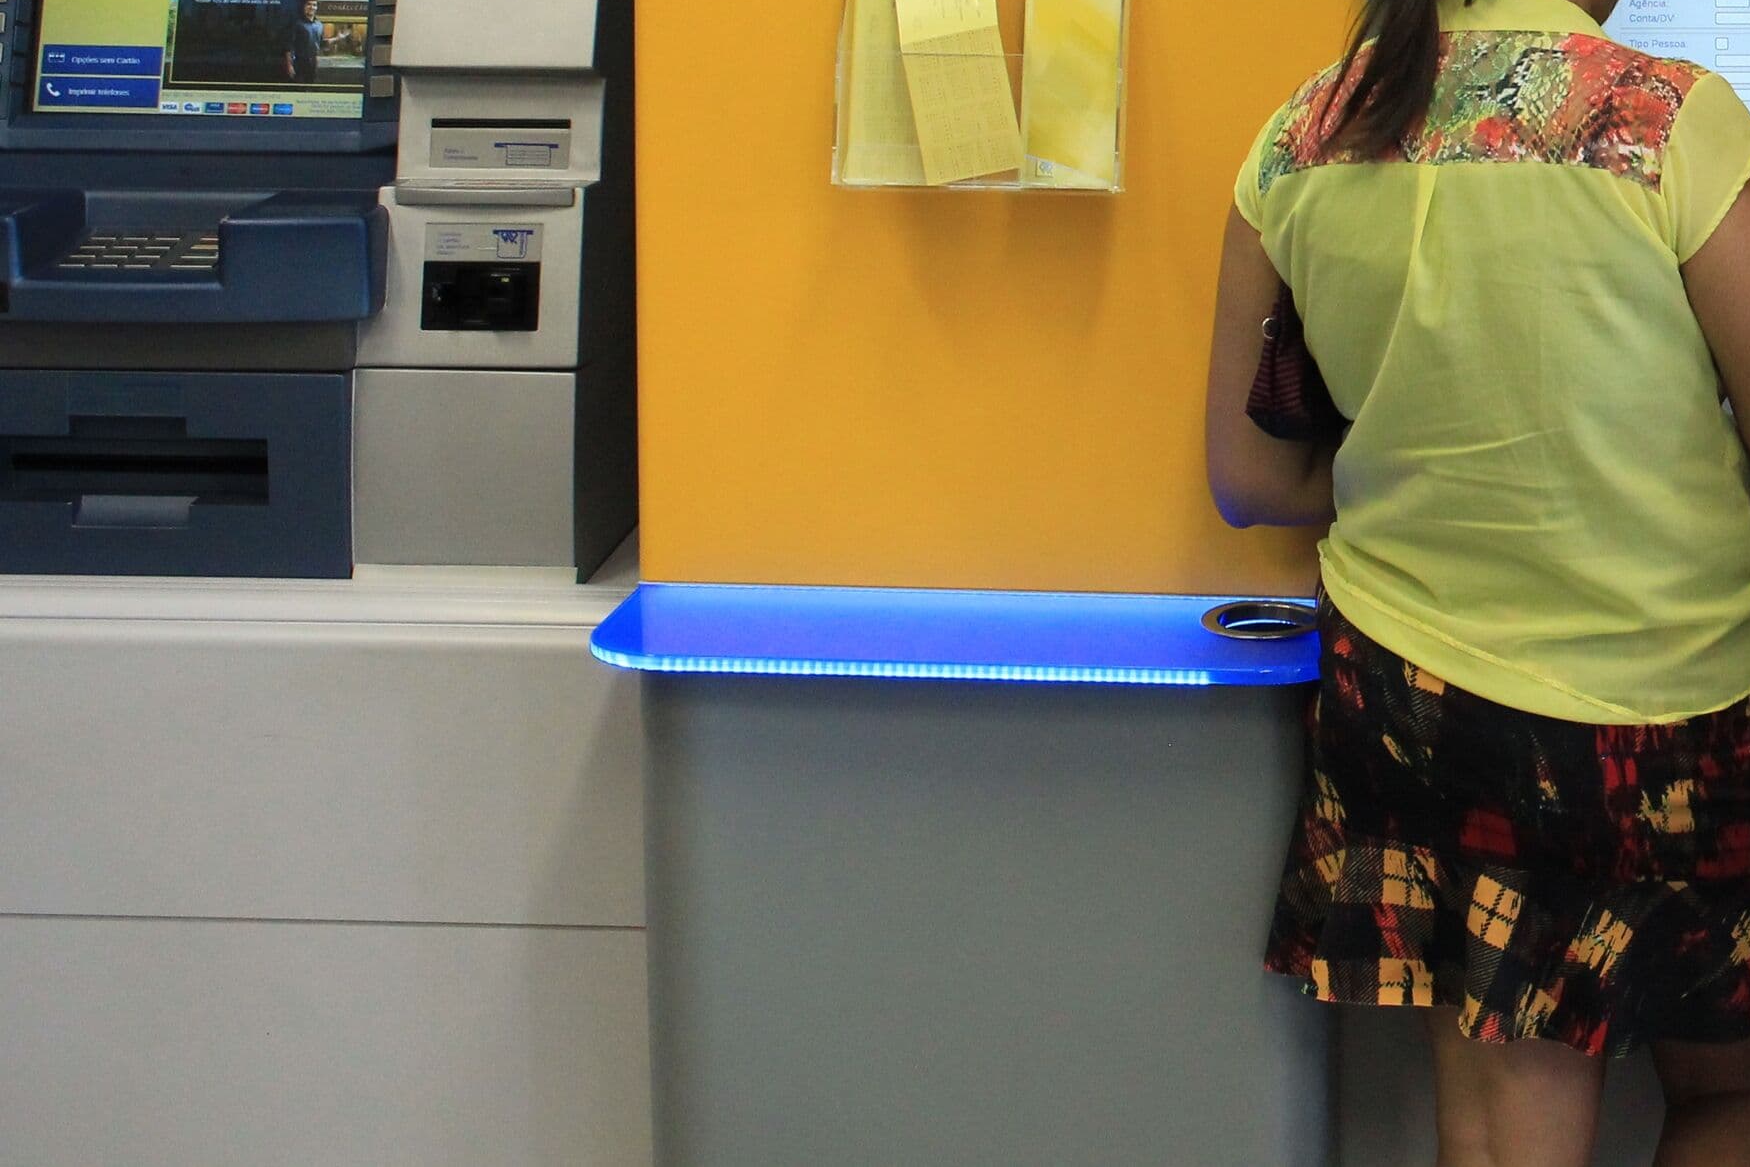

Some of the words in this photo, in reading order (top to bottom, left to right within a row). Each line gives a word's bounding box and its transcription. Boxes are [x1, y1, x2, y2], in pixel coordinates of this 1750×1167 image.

[1628, 39, 1649, 48] Tipo
[71, 56, 98, 64] Opções
[116, 56, 140, 64] Cartão
